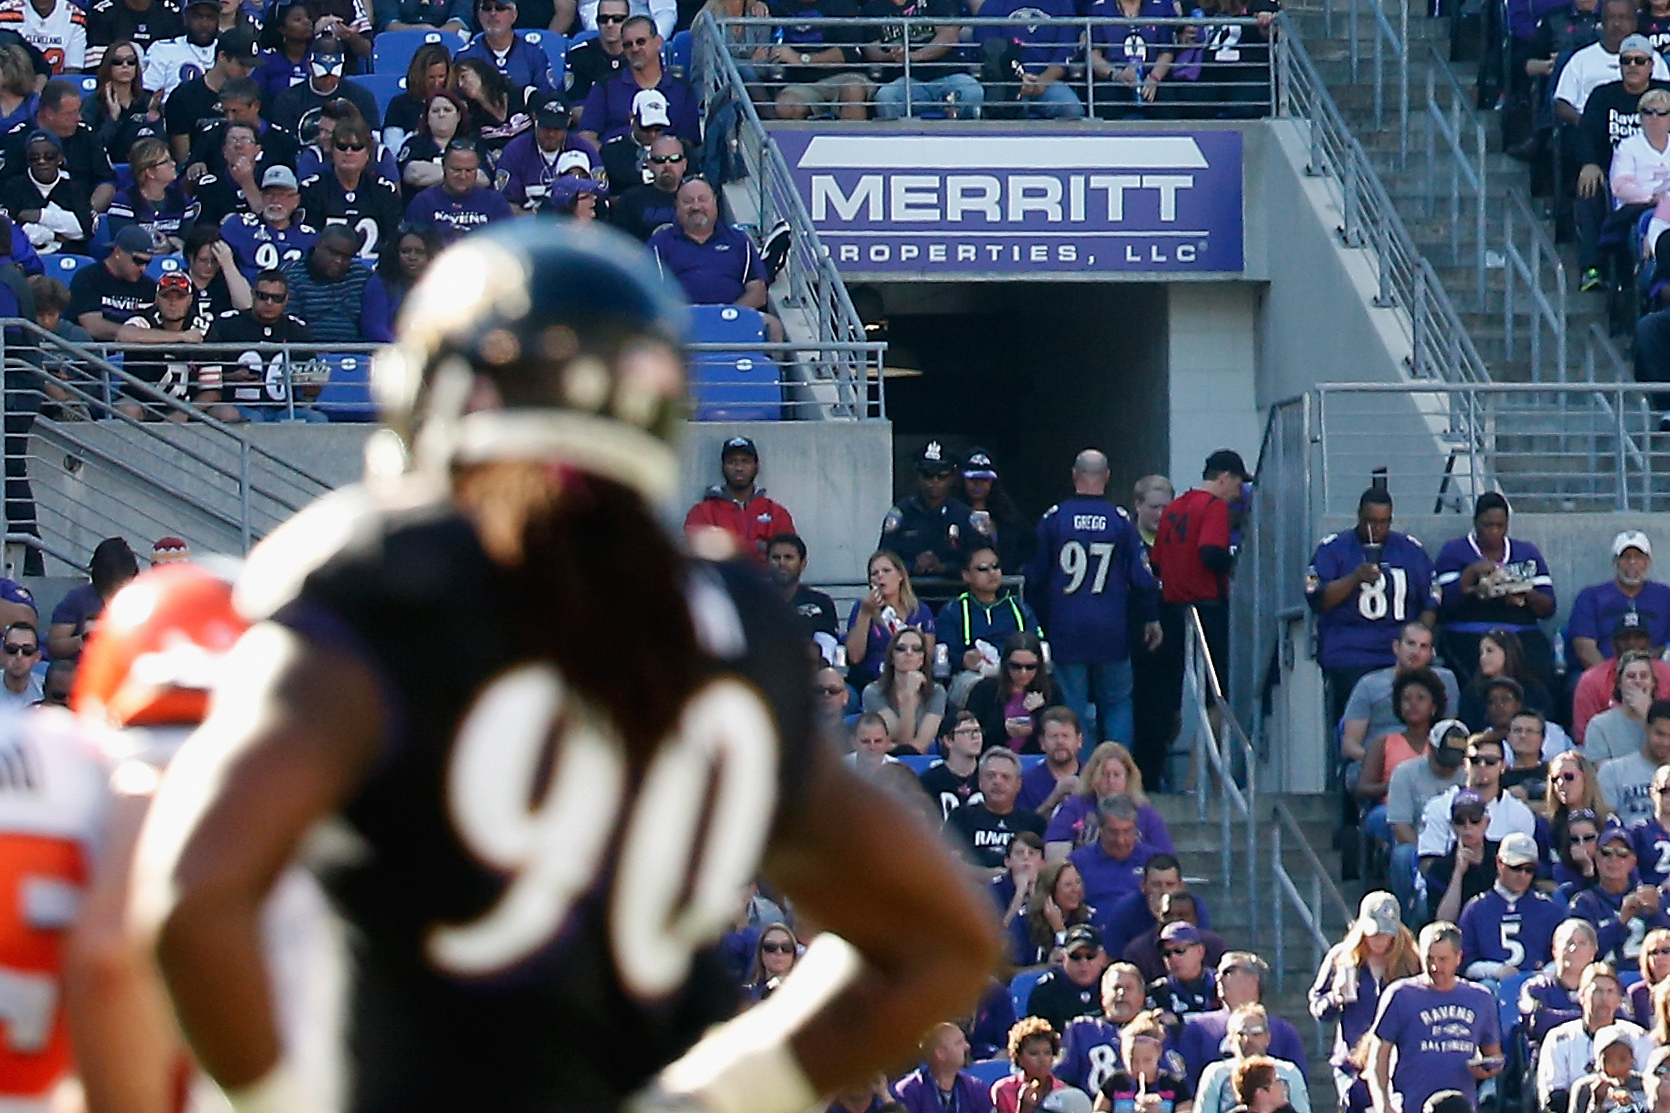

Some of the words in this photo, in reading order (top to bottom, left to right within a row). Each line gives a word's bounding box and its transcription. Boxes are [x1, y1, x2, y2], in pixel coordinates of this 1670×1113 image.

[810, 175, 1194, 223] MERRITT
[1125, 244, 1196, 263] LLC
[1074, 515, 1106, 532] GREGG
[1059, 542, 1115, 595] 97
[1358, 567, 1407, 622] 81
[424, 657, 782, 1003] 90
[975, 829, 1013, 848] RAVE
[1501, 922, 1525, 967] 5
[1420, 1005, 1475, 1026] RAVENS
